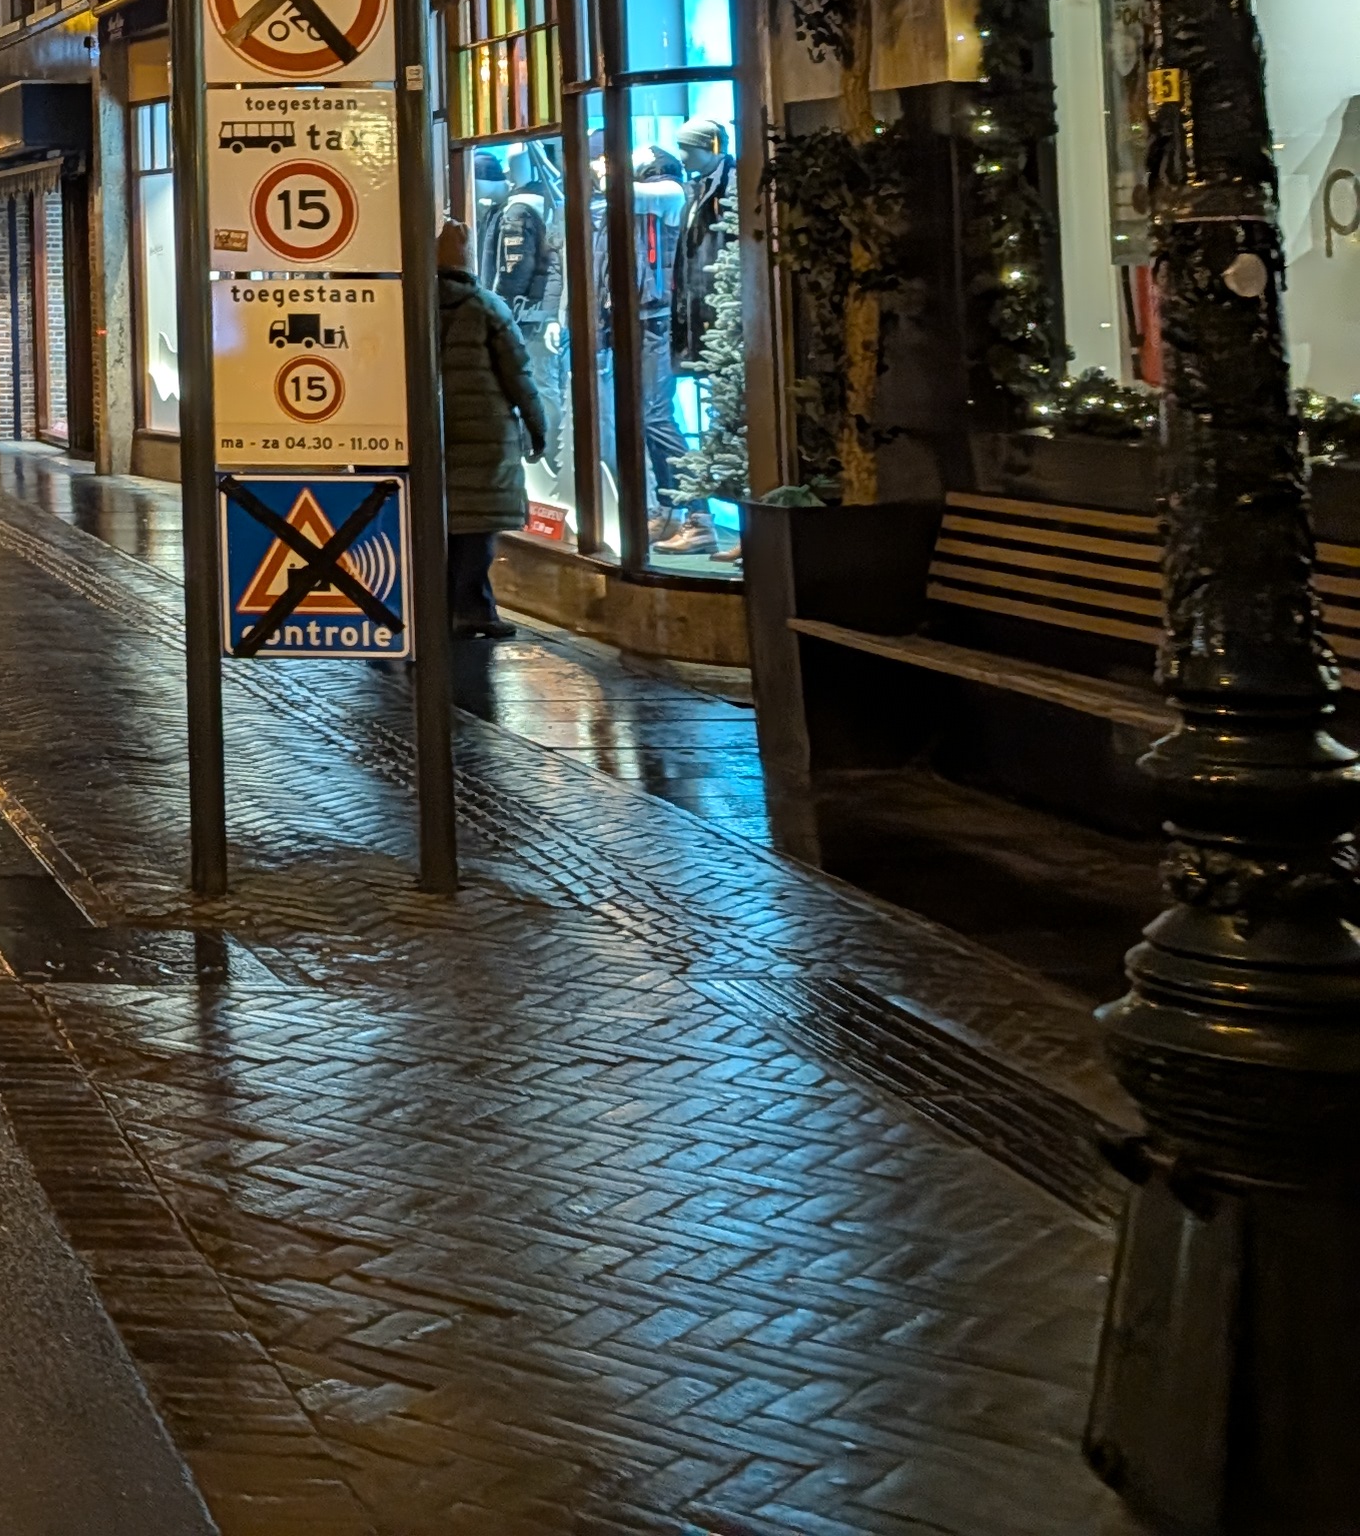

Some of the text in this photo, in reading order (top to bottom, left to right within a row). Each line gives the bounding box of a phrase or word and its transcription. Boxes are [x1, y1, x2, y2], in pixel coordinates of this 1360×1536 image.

[245, 96, 358, 116] toegestaan
[277, 189, 330, 231] 15
[231, 285, 375, 307] toegestaan
[291, 376, 327, 402] 15
[221, 438, 244, 448] ma
[261, 438, 280, 449] za
[285, 436, 333, 450] 04.30
[350, 437, 389, 451] 11.00
[395, 438, 404, 450] h
[241, 619, 393, 647] ntrole
